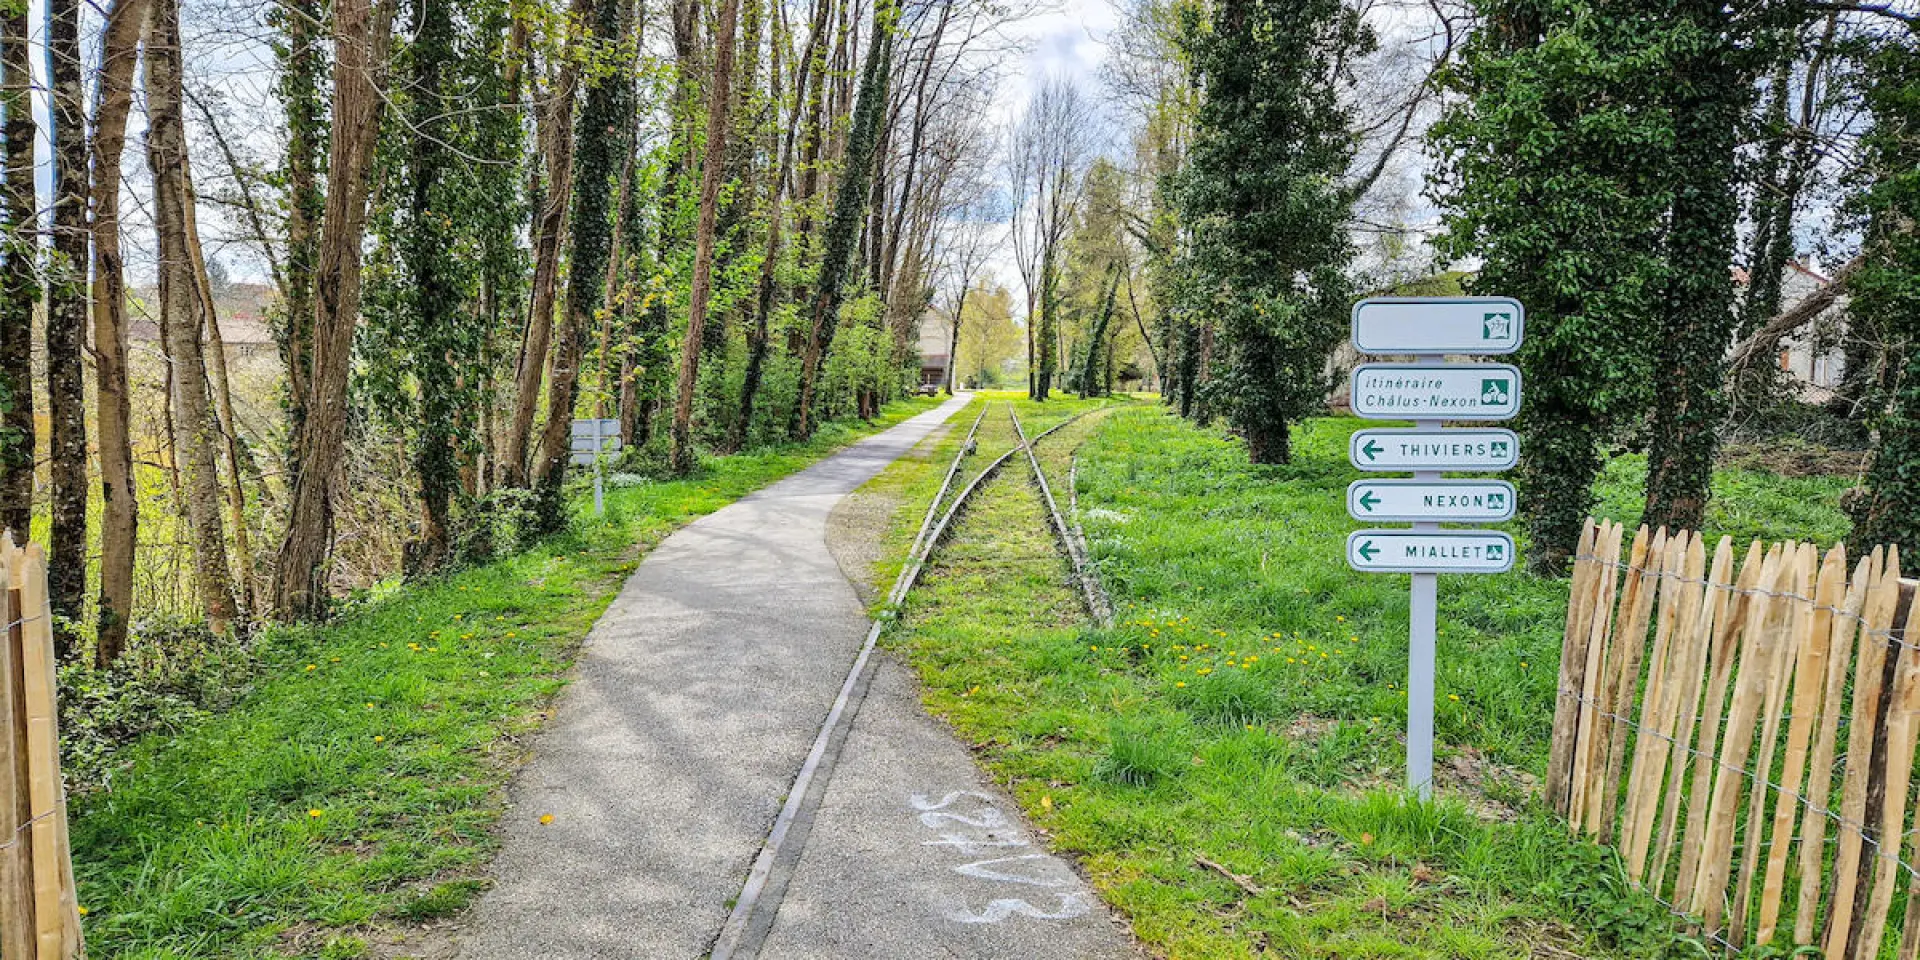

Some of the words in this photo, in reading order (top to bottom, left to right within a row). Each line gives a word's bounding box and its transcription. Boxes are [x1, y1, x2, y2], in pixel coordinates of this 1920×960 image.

[1365, 376, 1444, 390] itinéraire
[1400, 444, 1486, 457] THIVIERS
[1423, 495, 1483, 508] NEXON
[1405, 546, 1482, 558] MIALLET
